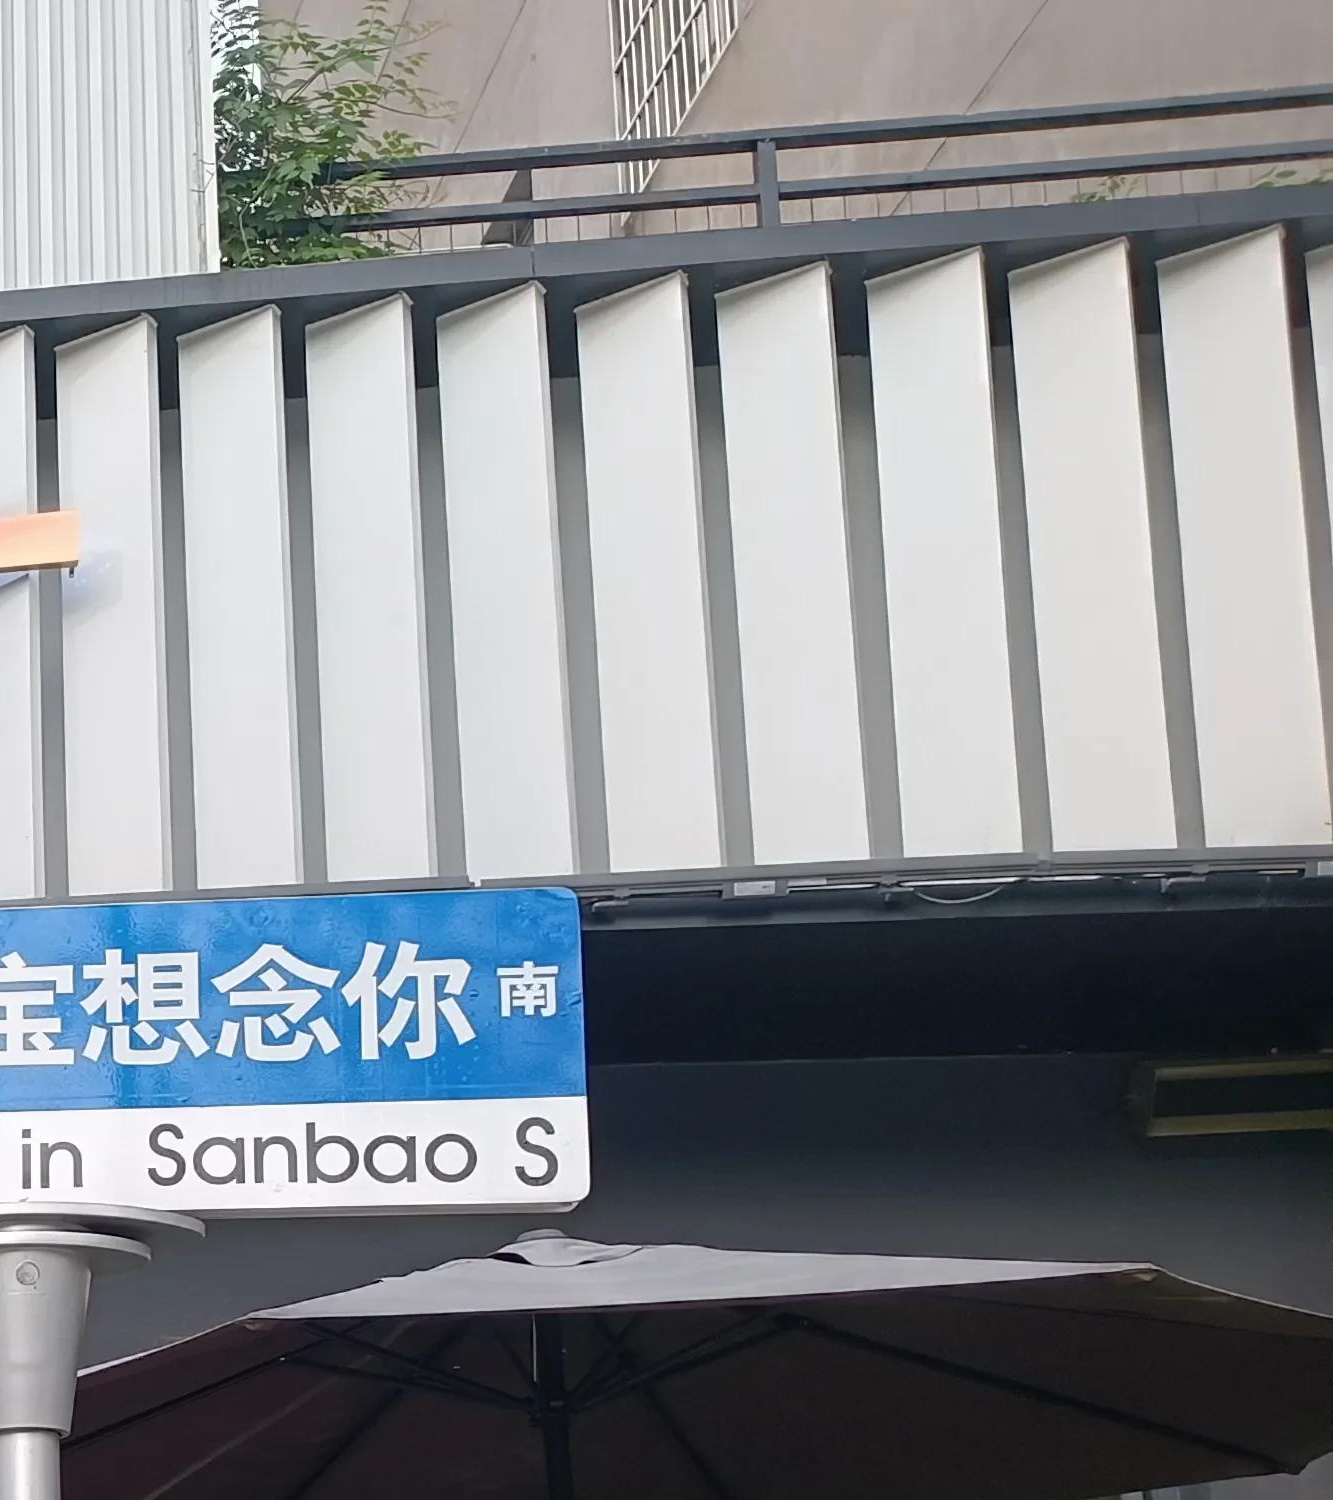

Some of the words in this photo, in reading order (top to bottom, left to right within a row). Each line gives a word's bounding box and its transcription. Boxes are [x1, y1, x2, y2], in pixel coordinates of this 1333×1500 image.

[498, 960, 558, 1020] 南
[20, 1127, 83, 1190] in
[147, 1121, 477, 1186] Sanbao
[514, 1116, 559, 1187] S
